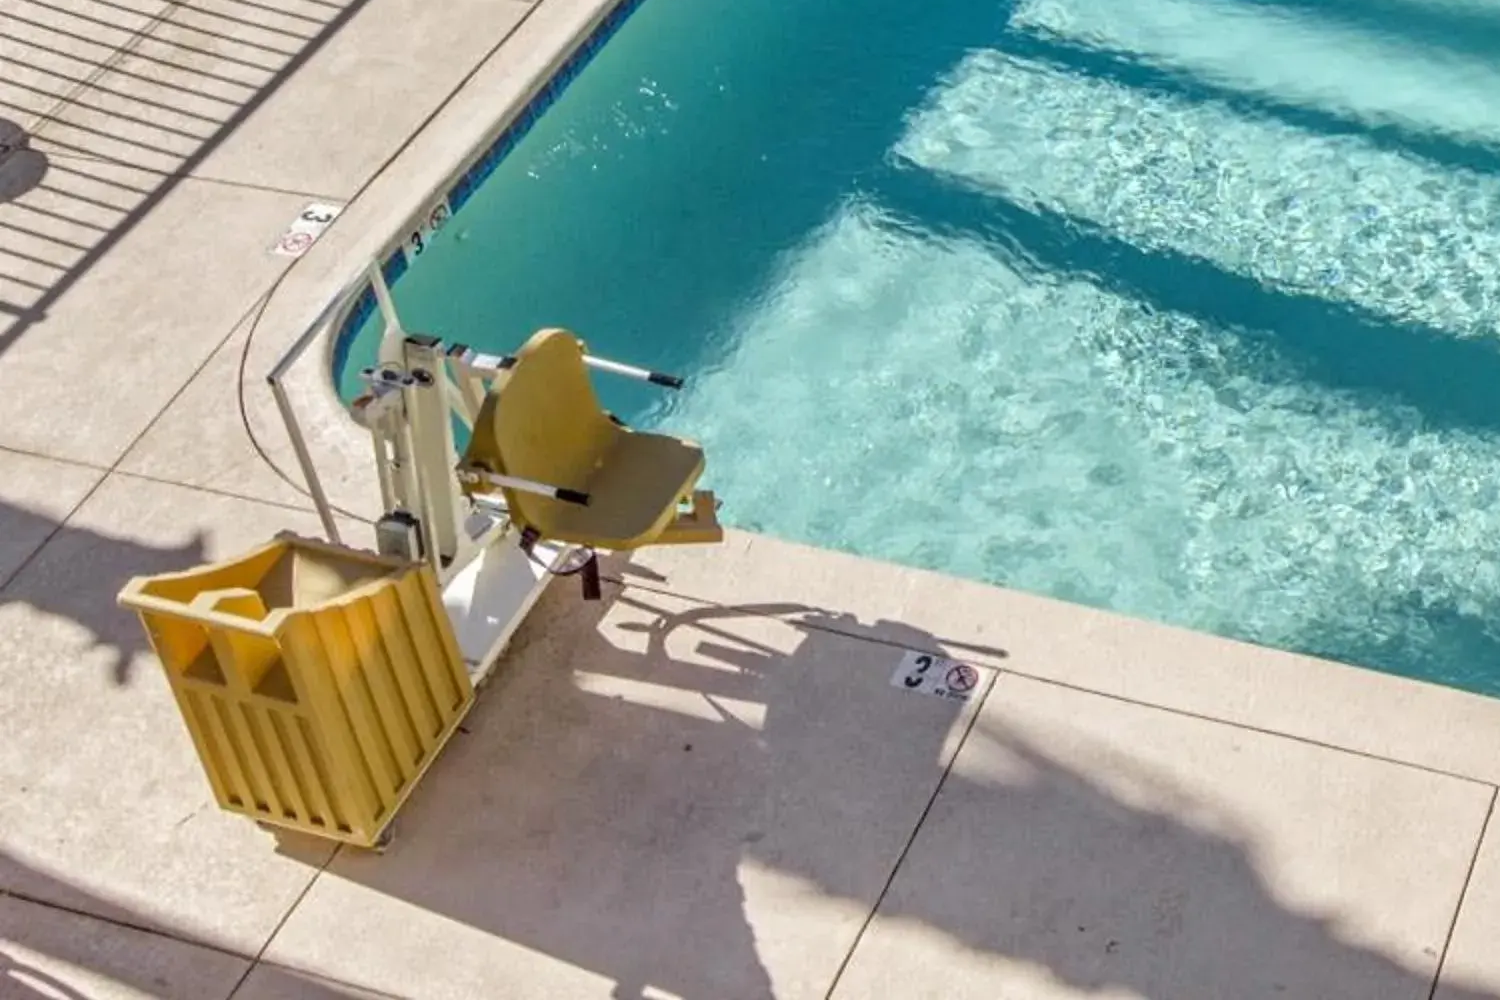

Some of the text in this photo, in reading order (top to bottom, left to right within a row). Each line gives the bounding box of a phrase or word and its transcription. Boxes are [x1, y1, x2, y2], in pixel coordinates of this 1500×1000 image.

[302, 210, 332, 223] 3
[411, 231, 424, 256] 3
[904, 655, 932, 688] 3
